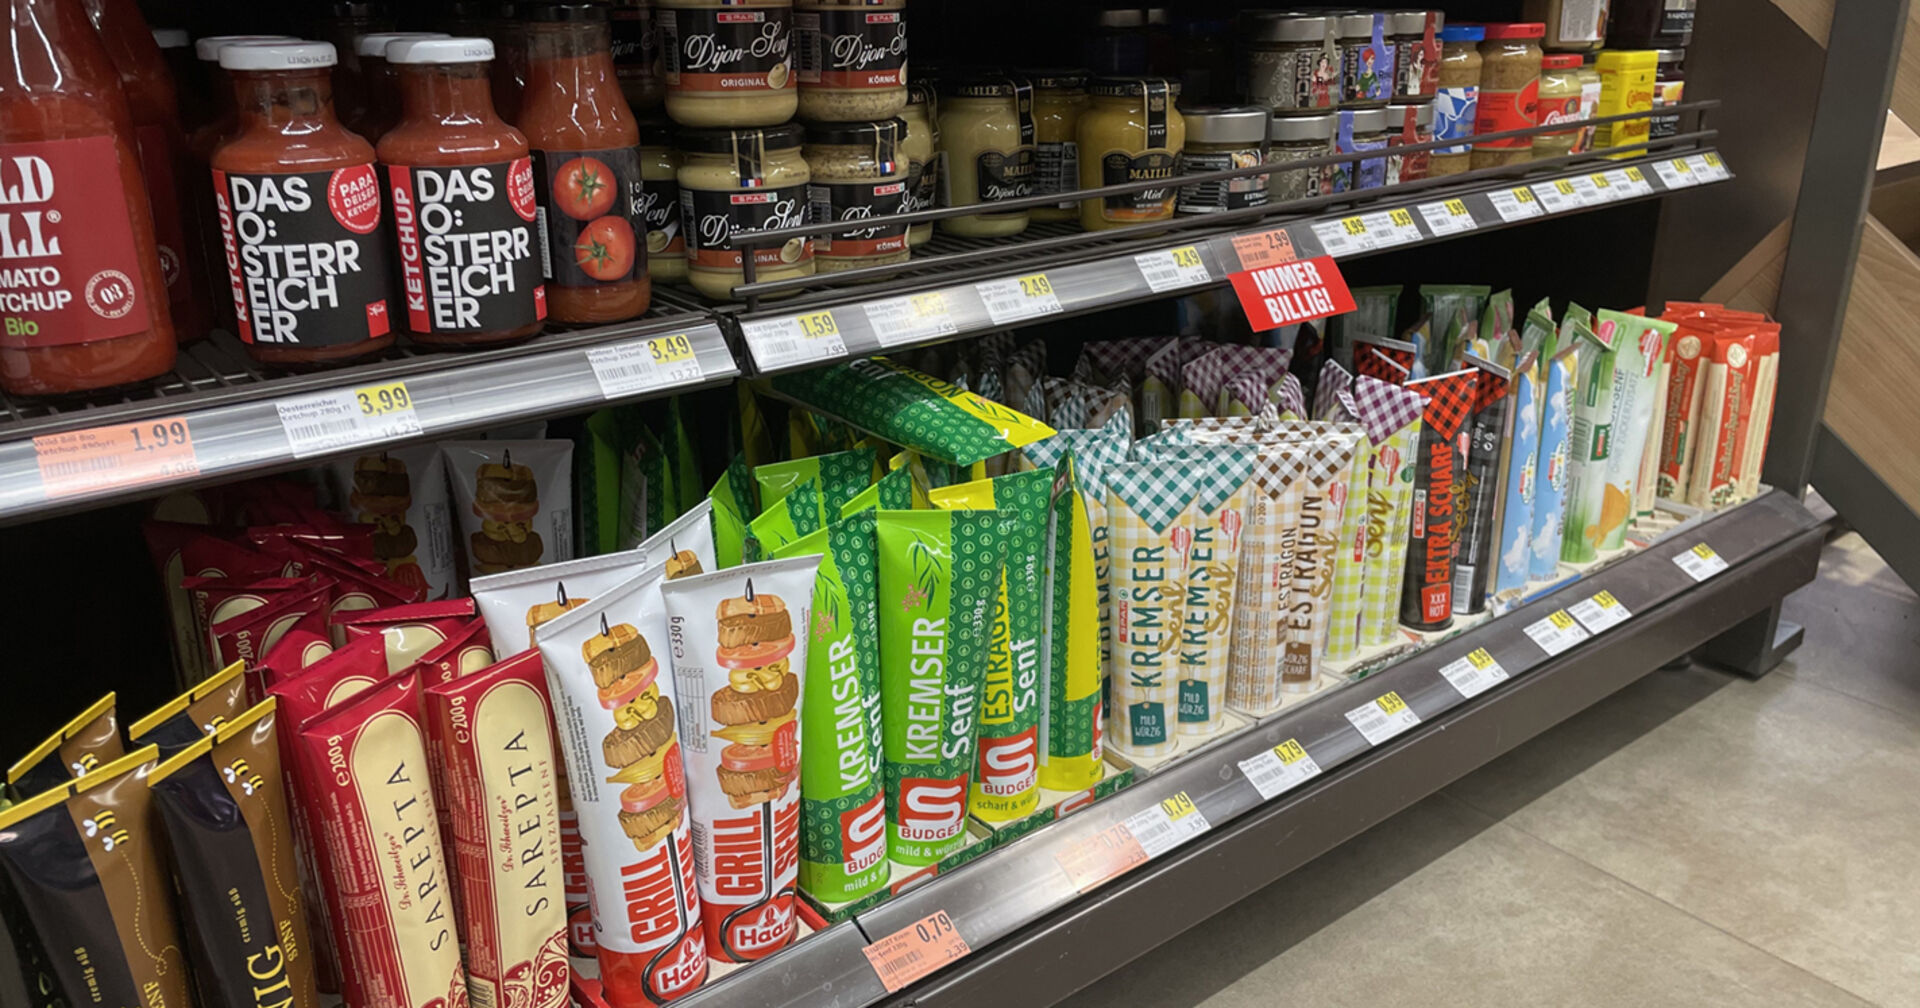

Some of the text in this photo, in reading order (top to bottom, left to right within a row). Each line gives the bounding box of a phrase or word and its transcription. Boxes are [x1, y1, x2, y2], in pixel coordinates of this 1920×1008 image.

[721, 78, 767, 88] ORIGINAL
[867, 75, 897, 85] KÖRNIG
[230, 176, 312, 213] DAS
[339, 173, 374, 198] PARA
[343, 187, 376, 209] DEISER
[416, 167, 496, 204] DAS
[984, 184, 1014, 201] Dijon
[1133, 188, 1166, 201] Miel
[1342, 218, 1367, 236] 3,99
[1390, 211, 1413, 228] 3,99
[394, 187, 425, 312] KETCHUP
[424, 226, 531, 267] STERR
[1265, 230, 1290, 251] 2,99
[217, 193, 248, 322] KETCHUP
[241, 239, 362, 279] STERR
[1173, 248, 1201, 269] 2,49
[100, 283, 125, 305] 03
[247, 274, 339, 311] EICH
[429, 260, 516, 298] EICH
[1020, 276, 1050, 299] 2,49
[1251, 261, 1323, 297] IMMER
[433, 296, 482, 329] ER
[1263, 286, 1336, 324] BILLIG!
[5, 317, 39, 336] Bio
[252, 308, 300, 343] ER
[800, 314, 836, 340] 1,59
[647, 336, 689, 360] 3,49
[824, 344, 846, 356] 7,95
[670, 365, 700, 381] 13,27
[278, 386, 409, 416] Oesterreicher 3,99
[130, 421, 187, 452] 1,99
[1425, 441, 1454, 584] EXTRA SCHARF
[1278, 527, 1297, 611] ESTRAGON
[1309, 531, 1340, 601] Senf
[1180, 526, 1214, 666] KREMSER
[1204, 562, 1236, 637] Senf
[1429, 604, 1445, 618] HOT
[1430, 592, 1446, 602] XXX
[1130, 545, 1165, 688] KREMSER
[1157, 581, 1187, 656] Senf
[905, 617, 946, 760] KREMSER
[1009, 637, 1036, 714] Senf
[828, 633, 868, 792] KREMSER
[1183, 691, 1201, 704] MILD
[1376, 691, 1403, 714] 0,99
[941, 683, 975, 760] Senf
[1139, 714, 1157, 725] MILD
[1273, 740, 1303, 764] 0,79
[984, 772, 1037, 795] BUDGET
[976, 800, 1009, 811] scharf
[1160, 793, 1192, 817] 0,79
[504, 728, 549, 917] SAREPTA
[901, 822, 963, 840] BUDGET
[387, 760, 449, 953] SAREPTA
[713, 810, 763, 897] GRILL
[896, 844, 931, 857] mild &
[620, 845, 680, 945] GRILL
[844, 876, 868, 893] mild
[279, 918, 299, 962] SENF
[915, 913, 953, 944] 0,79
[945, 941, 968, 958] 2,39
